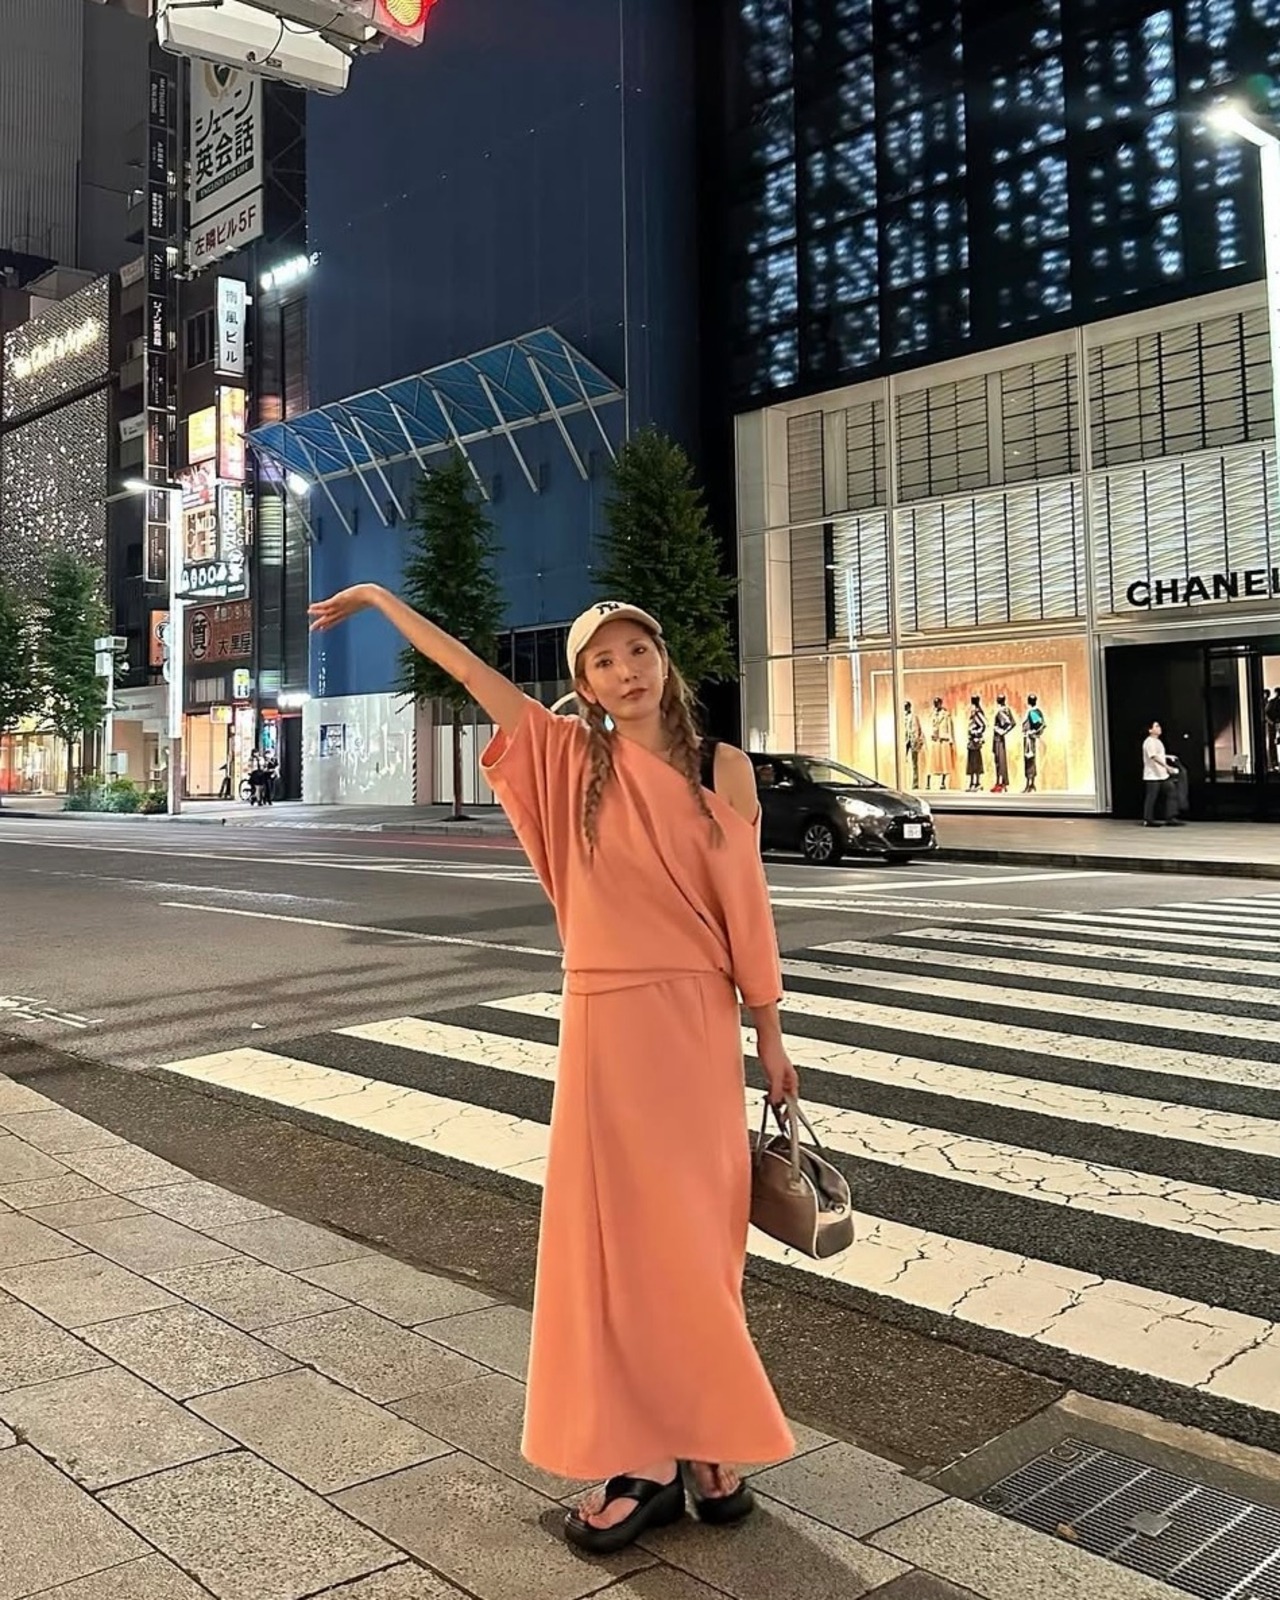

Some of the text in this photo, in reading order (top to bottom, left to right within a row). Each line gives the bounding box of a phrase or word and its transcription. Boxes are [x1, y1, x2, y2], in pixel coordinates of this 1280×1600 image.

[196, 81, 253, 146] シェーン
[196, 114, 254, 185] 英会話
[194, 204, 256, 256] 左隣ビル5F
[218, 632, 251, 655] 大黒屋
